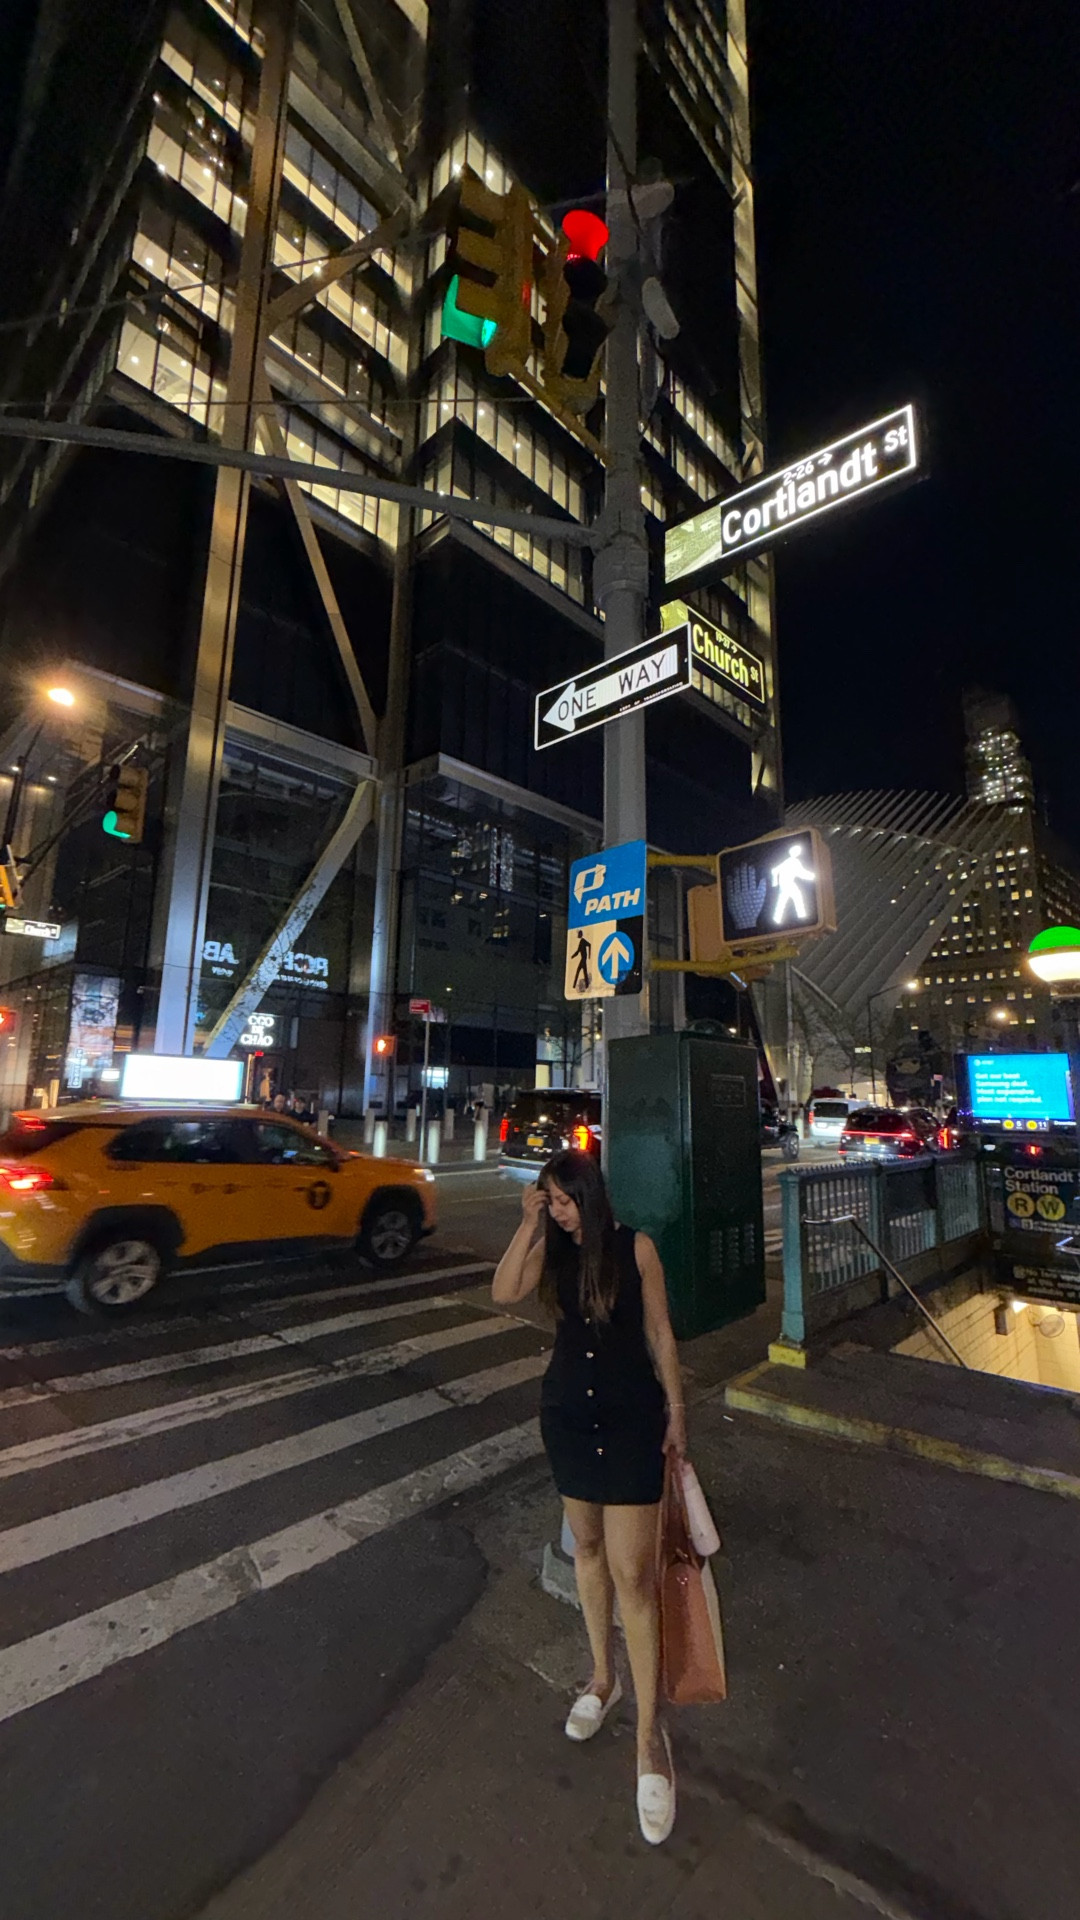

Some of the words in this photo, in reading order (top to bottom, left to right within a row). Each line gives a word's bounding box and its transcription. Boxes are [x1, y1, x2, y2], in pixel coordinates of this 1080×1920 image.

[722, 442, 878, 544] Cortlandt
[884, 425, 908, 453] St
[783, 461, 814, 486] 2-26
[693, 624, 749, 687] Church
[750, 666, 759, 683] St
[557, 686, 597, 721] ONE
[618, 654, 666, 694] WAY
[585, 888, 640, 916] PATH
[1004, 1166, 1074, 1183] Cortlandt
[1005, 1180, 1059, 1194] Station
[1014, 1197, 1028, 1212] R
[1041, 1200, 1060, 1216] W
